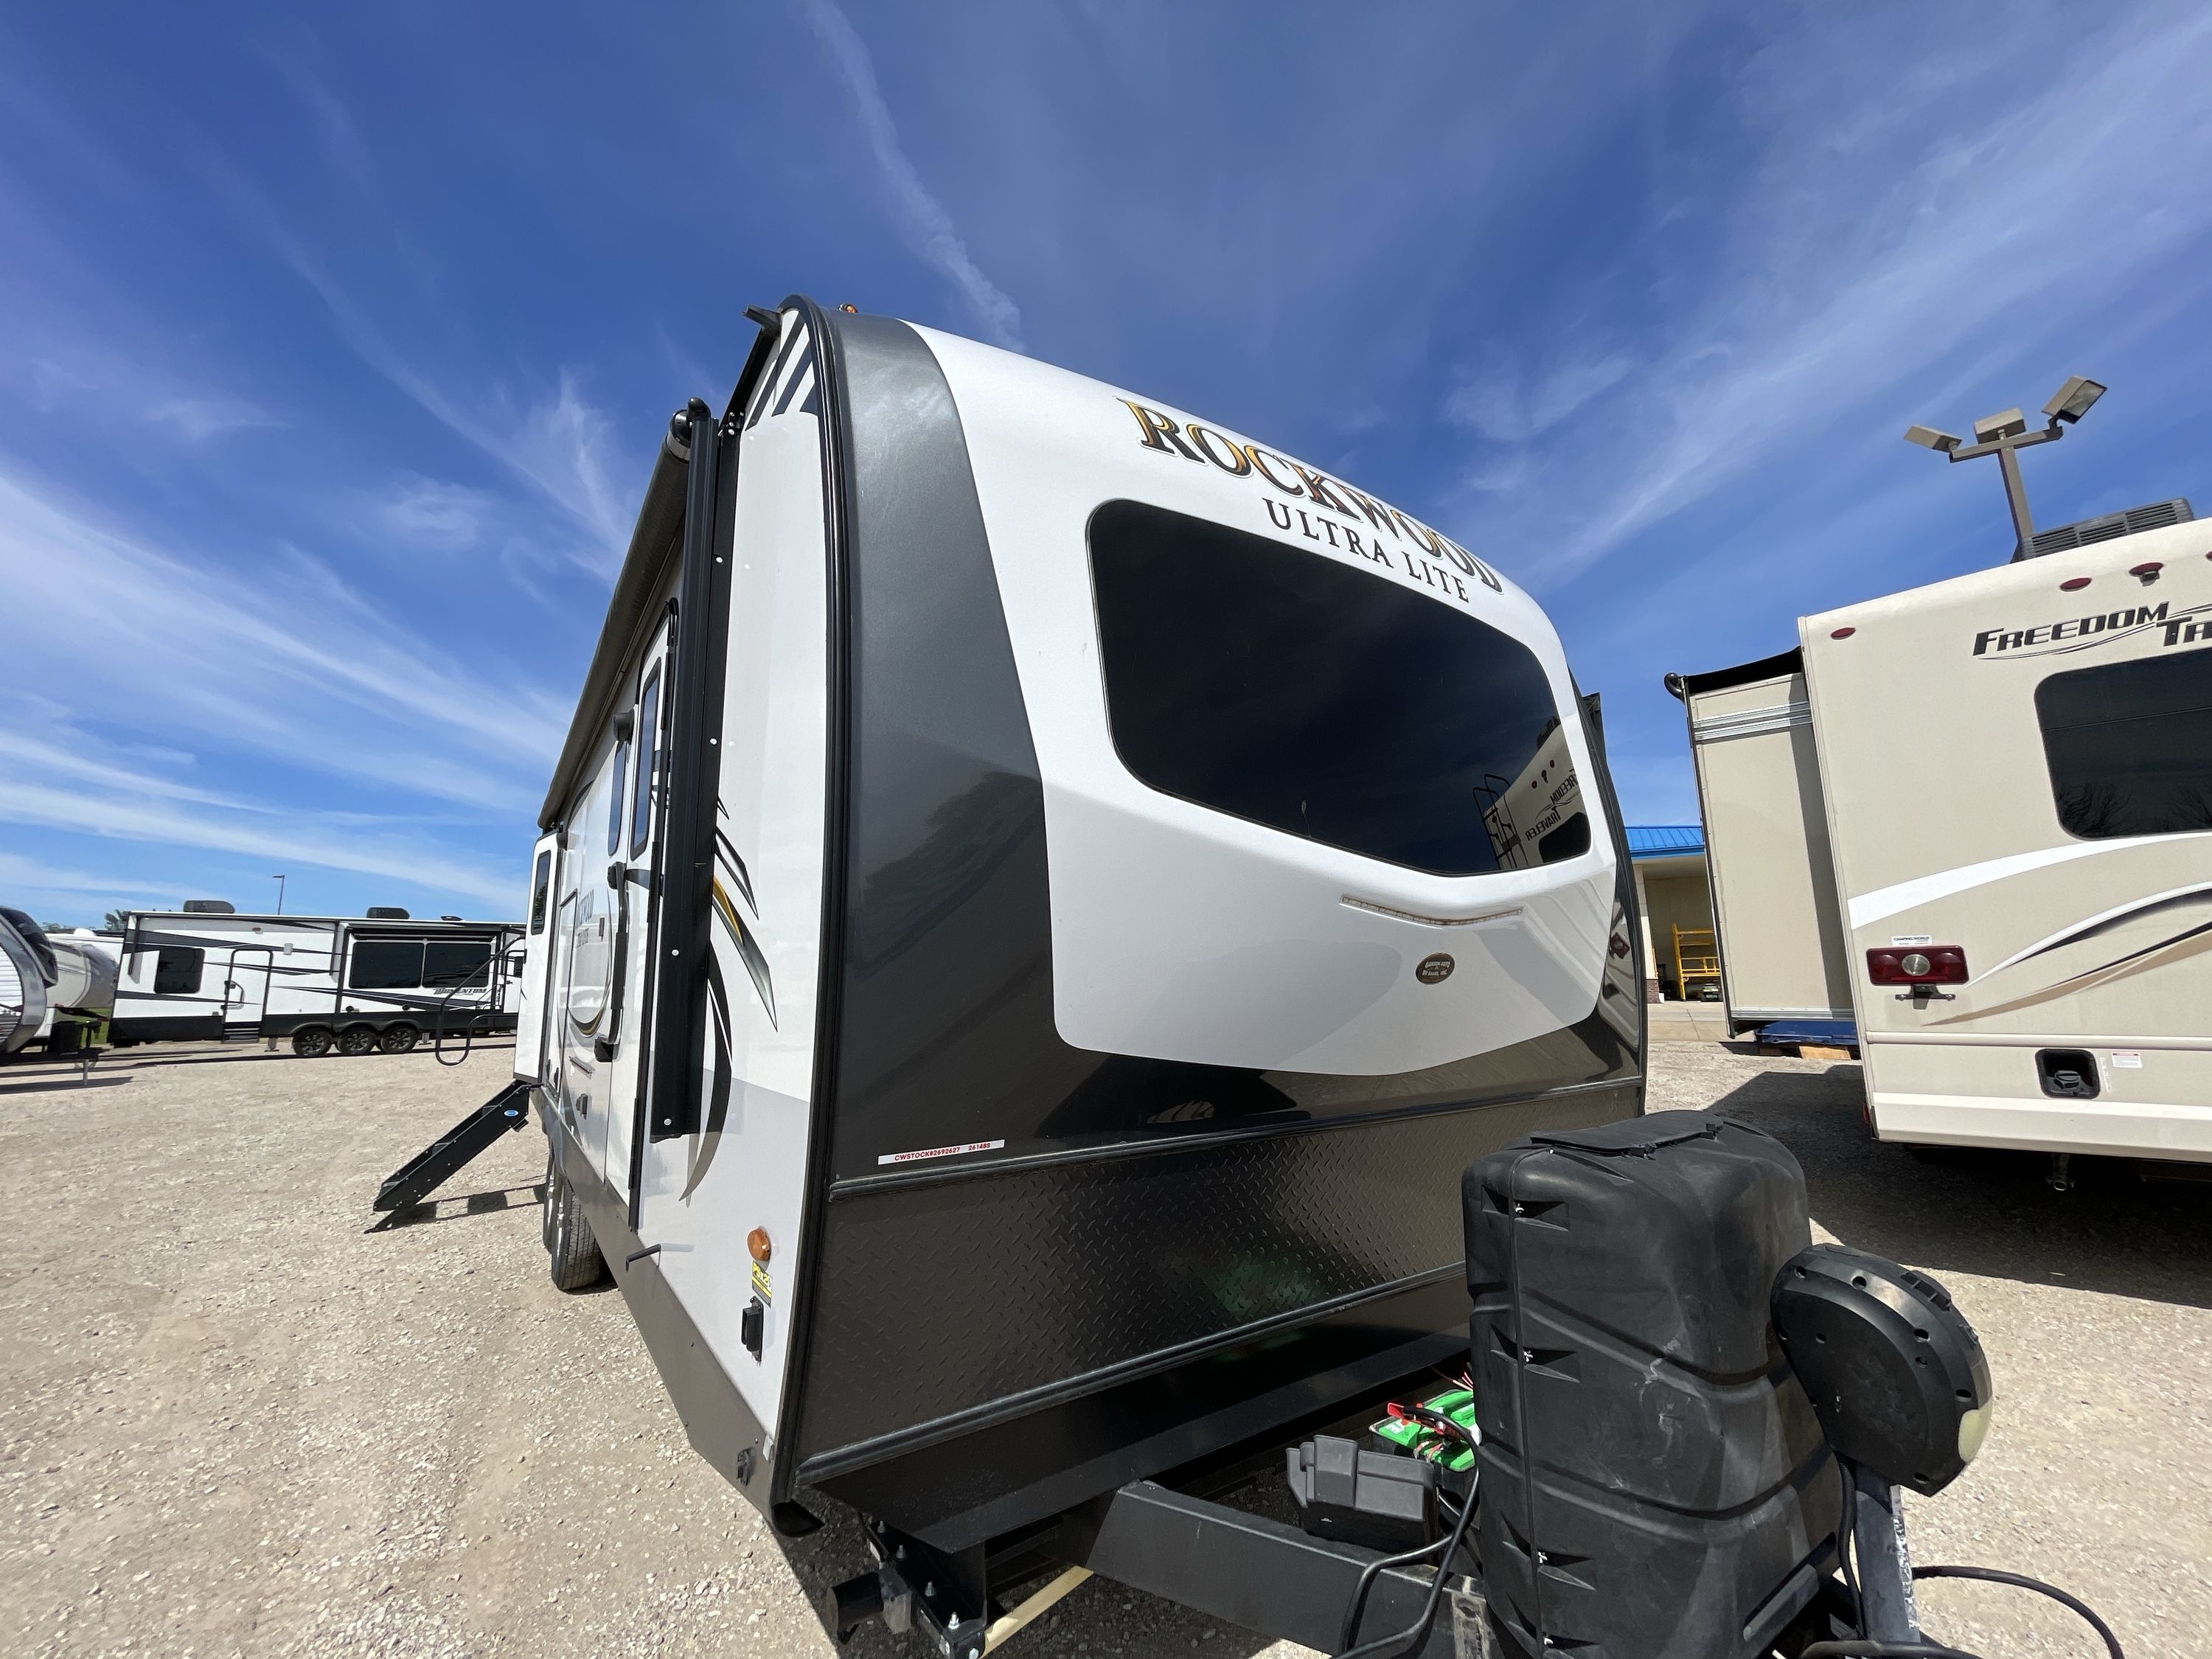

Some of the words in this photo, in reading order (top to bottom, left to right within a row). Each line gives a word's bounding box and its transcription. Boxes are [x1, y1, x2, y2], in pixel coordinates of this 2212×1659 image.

[1115, 397, 1503, 593] ROCKWOOD
[1262, 497, 1394, 568] ULTRA
[1400, 550, 1470, 603] LITE
[1972, 600, 2169, 656] FREEDOM
